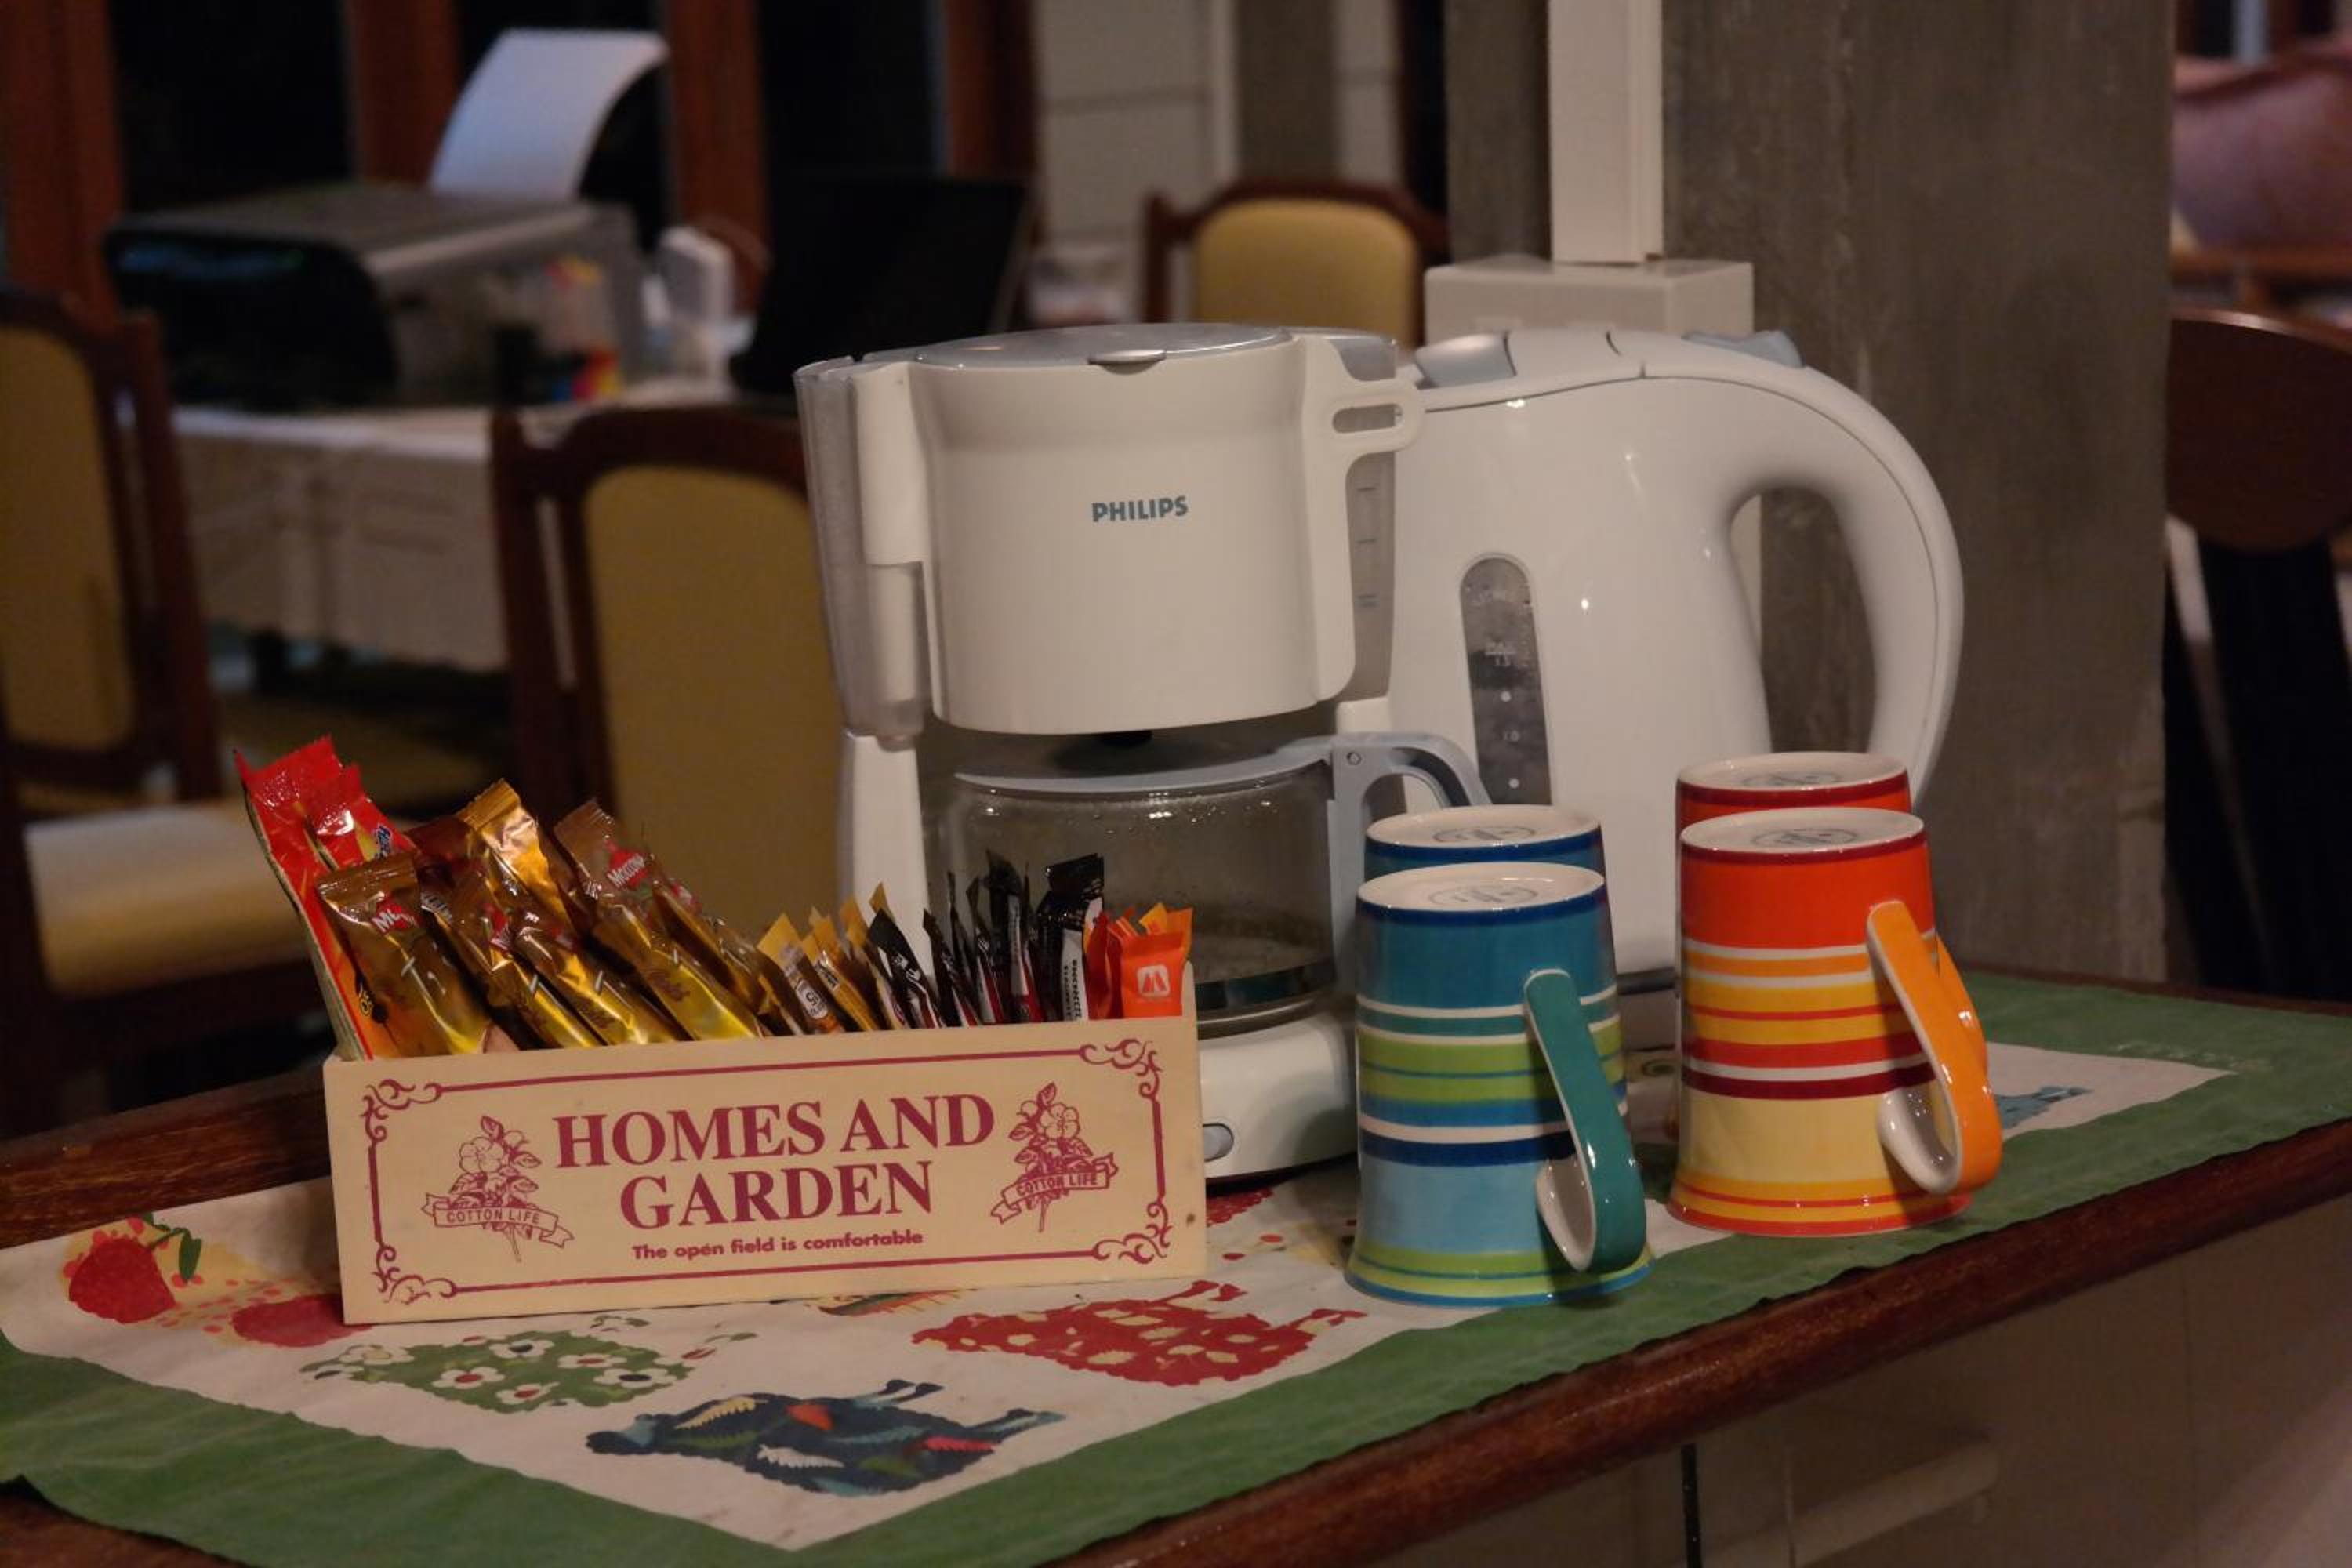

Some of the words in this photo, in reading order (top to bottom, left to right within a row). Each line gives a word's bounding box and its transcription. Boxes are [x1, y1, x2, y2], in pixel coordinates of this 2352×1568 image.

[1091, 495, 1189, 523] PHILIPS
[552, 1100, 826, 1168] HOMES
[839, 1094, 996, 1153] AND
[619, 1160, 932, 1229] GARDEN
[1015, 1175, 1065, 1196] COTTON
[1069, 1174, 1098, 1186] LIFE
[446, 1207, 503, 1223] COTTON
[508, 1208, 541, 1224] LIFE
[631, 1243, 668, 1260] The
[674, 1243, 725, 1261] open
[730, 1237, 775, 1254] field
[781, 1236, 797, 1251] is
[802, 1229, 924, 1250] comfortable
